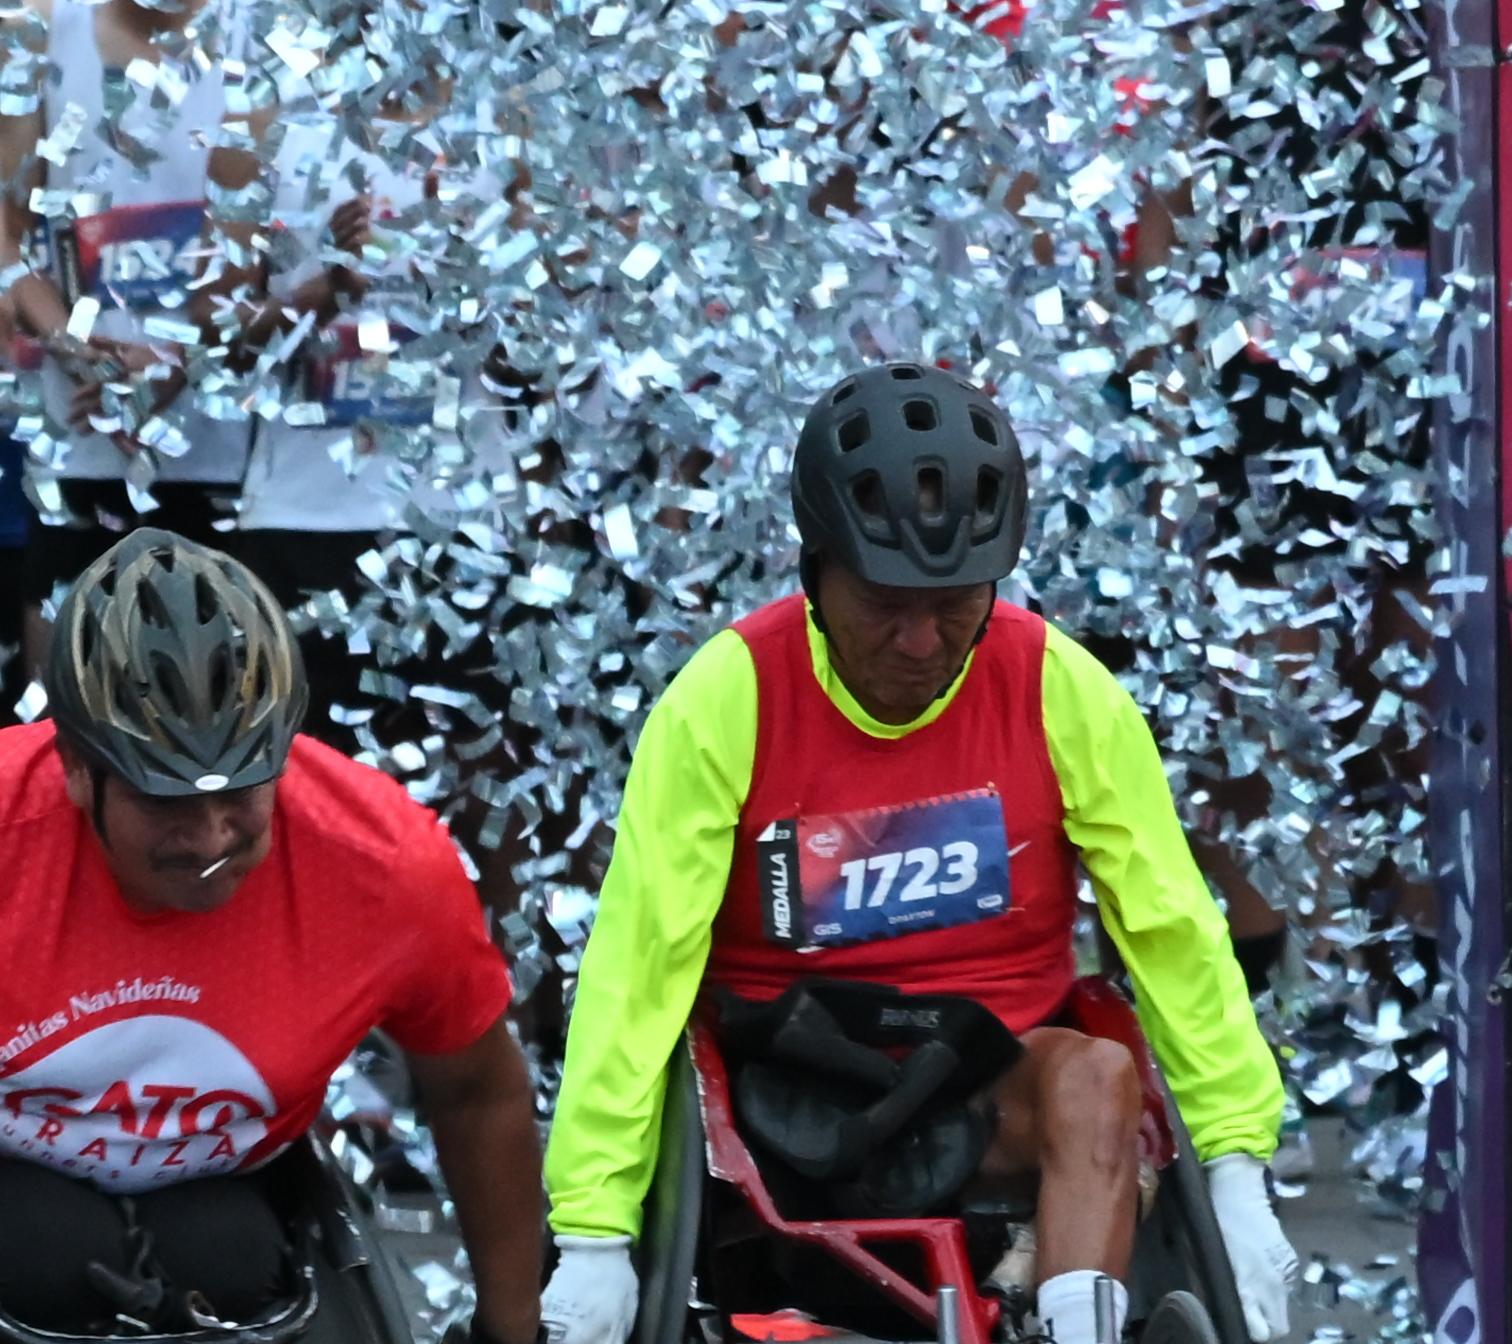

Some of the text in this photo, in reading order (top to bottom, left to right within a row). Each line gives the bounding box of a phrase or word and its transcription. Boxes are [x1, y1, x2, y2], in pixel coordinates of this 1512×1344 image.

[769, 852, 793, 939] MEDALLA
[840, 841, 979, 911] 1723
[69, 975, 202, 1021] Navideñas
